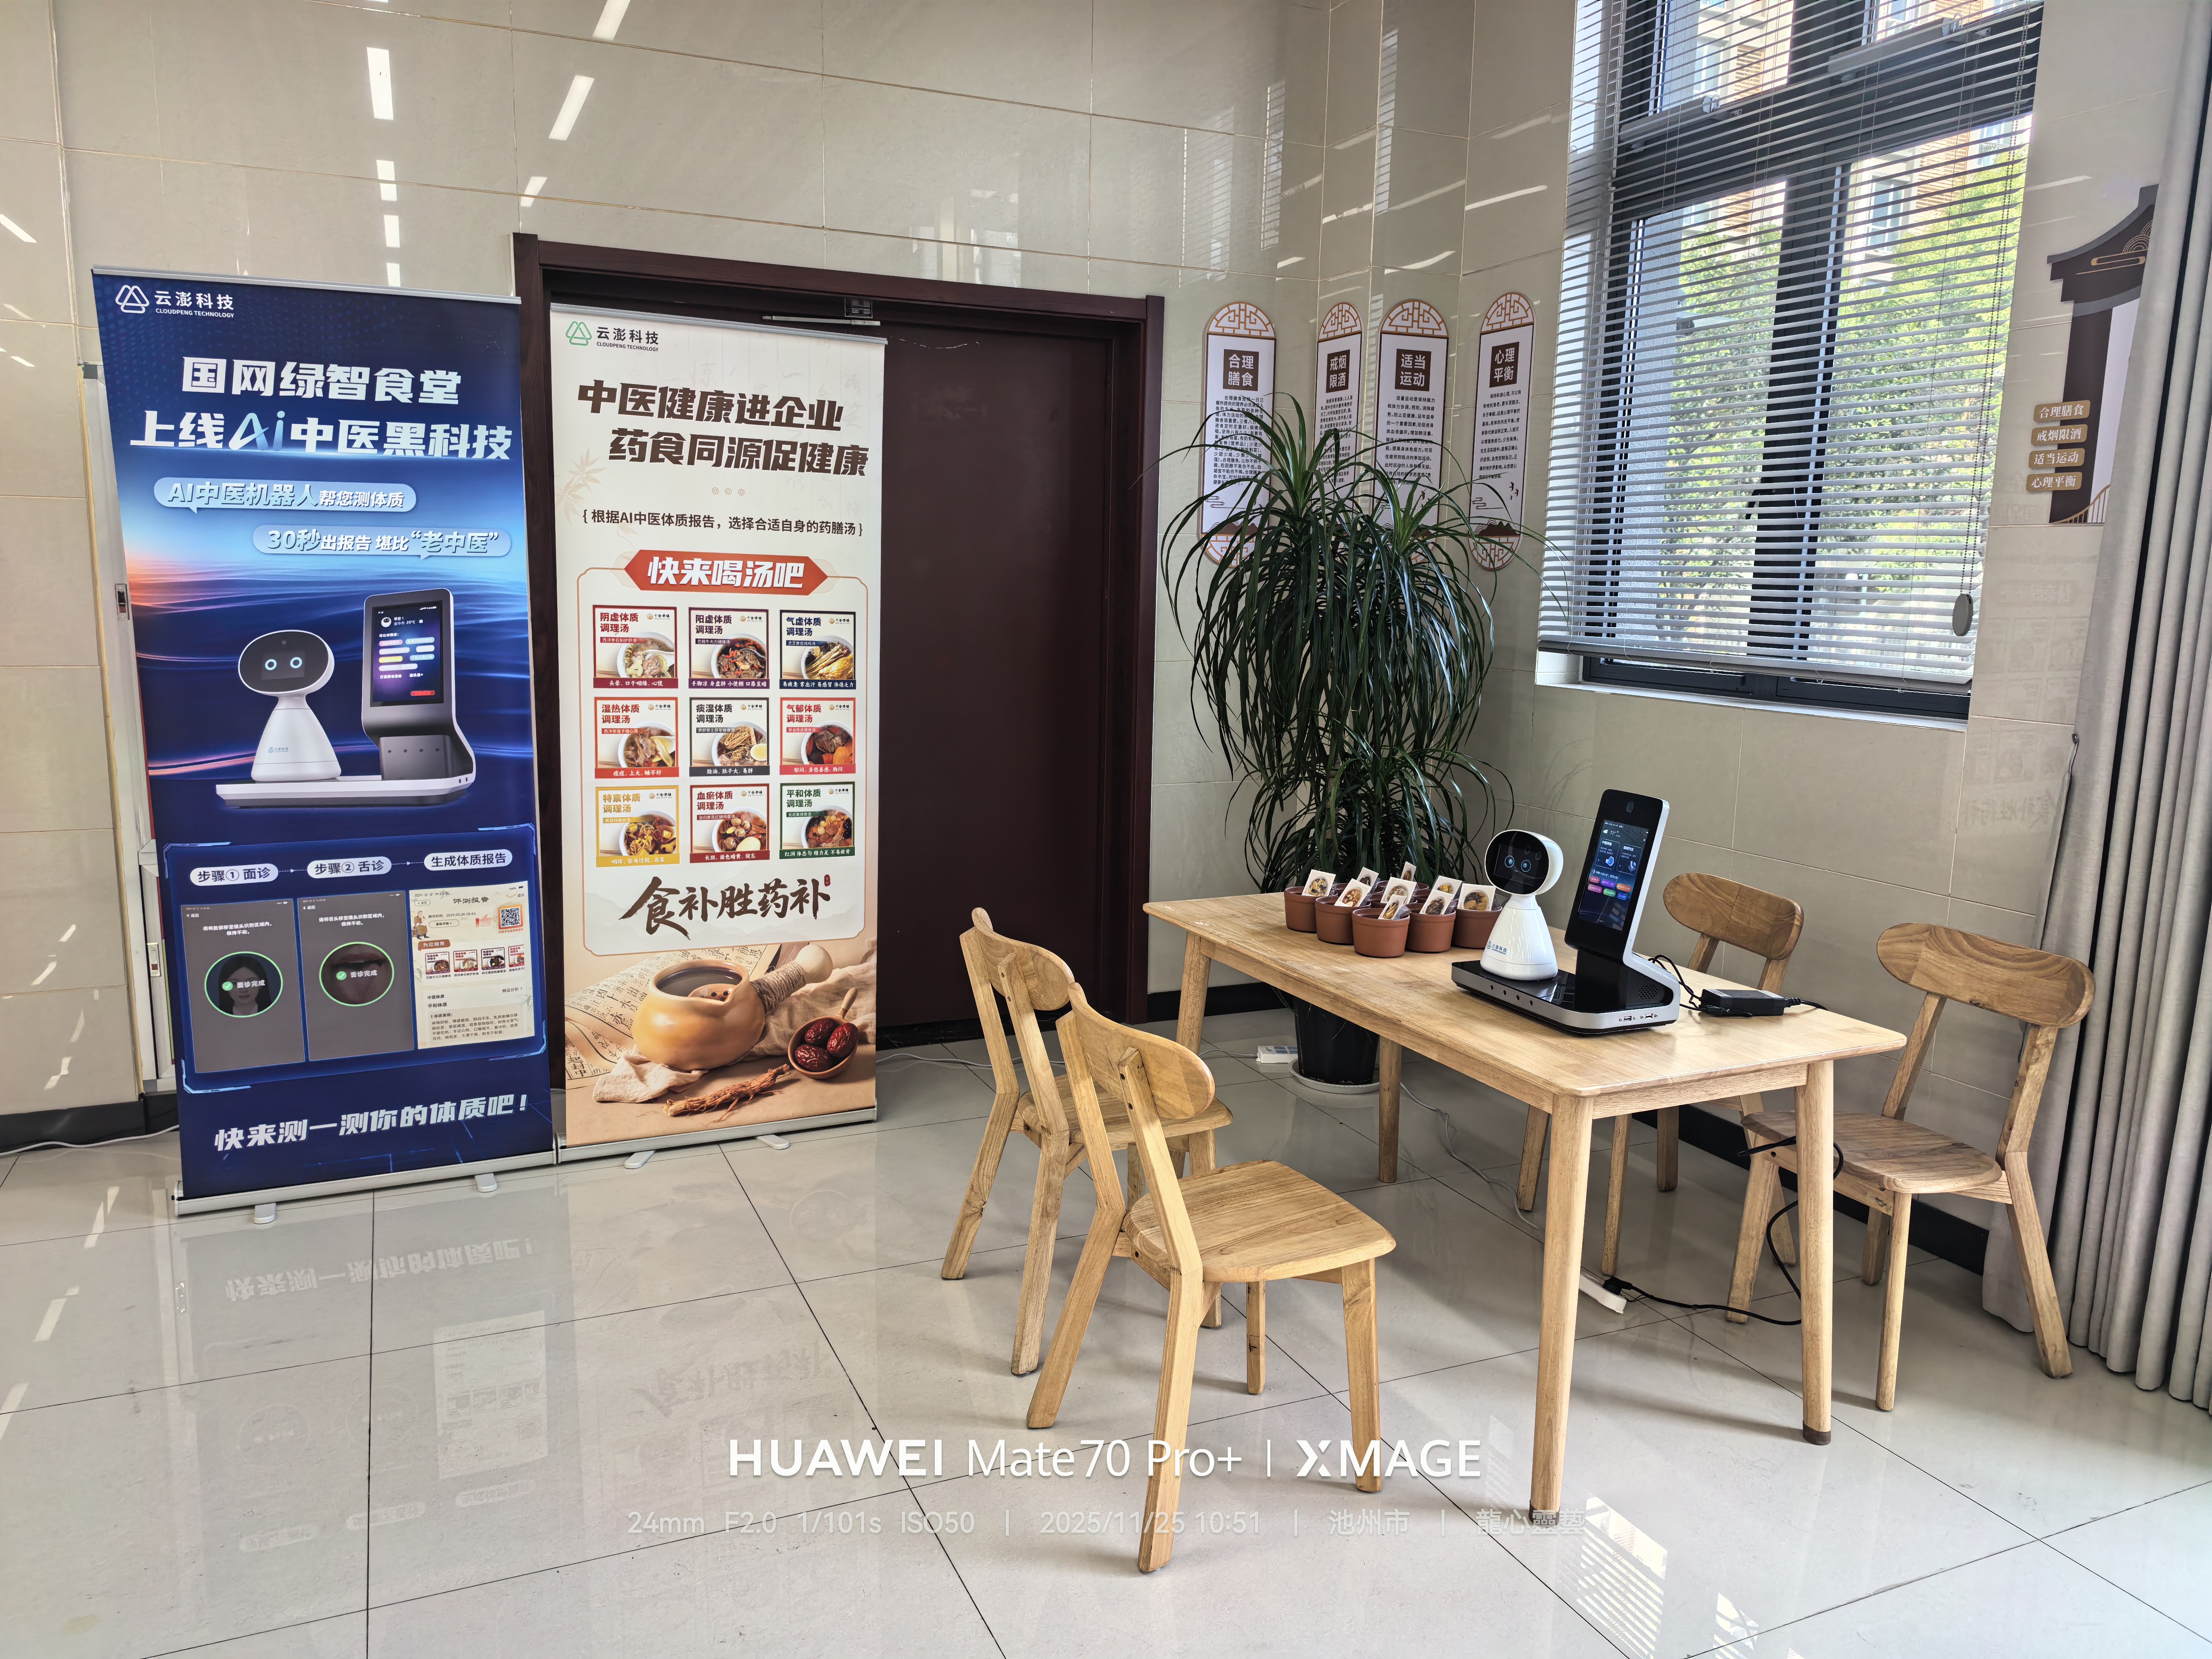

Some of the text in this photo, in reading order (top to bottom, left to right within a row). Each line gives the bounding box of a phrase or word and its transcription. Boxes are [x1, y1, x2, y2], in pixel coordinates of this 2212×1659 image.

[155, 291, 234, 310] 云澎科技
[156, 308, 234, 318] CLOUDPENG TECHNOLOGY
[597, 326, 659, 345] 云澎科技
[1495, 347, 1515, 364] 心理
[1229, 354, 1254, 370] 合理
[1330, 356, 1346, 372] 戒烟
[1401, 353, 1426, 370] 适当
[1228, 371, 1253, 387] 膳食
[1401, 371, 1425, 387] 运动
[1494, 365, 1513, 382] 平衡
[182, 356, 461, 404] 国网绿智食堂
[1329, 373, 1346, 389] 限酒
[578, 379, 844, 431] 中医健康进企业
[2040, 404, 2084, 419] 合理膳食
[2036, 428, 2082, 442] 戒烟限酒
[609, 428, 869, 477] 药食同源促健康
[2034, 451, 2079, 465] 适当运动
[2031, 475, 2076, 488] 心理平衡
[647, 556, 805, 589] 快来喝汤吧
[600, 613, 639, 622] 阴虚体质
[695, 615, 732, 624] 阳虚体质
[786, 617, 821, 626] 气虚体质
[600, 623, 629, 632] 调理汤
[695, 625, 723, 634] 调理汤
[786, 628, 813, 636] 调理汤
[602, 704, 640, 713] 湿热体质
[696, 704, 732, 713] 痰湿体质
[786, 704, 821, 713] 气郁体质
[602, 715, 630, 724] 调理汤
[696, 714, 724, 723] 调理汤
[786, 714, 813, 723] 调理汤
[603, 793, 641, 803] 特禀体质
[697, 791, 733, 800] 血瘀体质
[786, 789, 821, 798] 平和体质
[603, 804, 631, 813] 调理汤
[697, 801, 724, 810] 调理汤
[786, 799, 813, 808] 调理汤
[430, 852, 507, 868] 生成体质报告
[619, 876, 831, 940] 食补胜药补
[350, 969, 377, 979] 舌诊完成
[237, 980, 265, 989] 面诊完成
[214, 1094, 528, 1151] 快来测一测你的体质吧！
